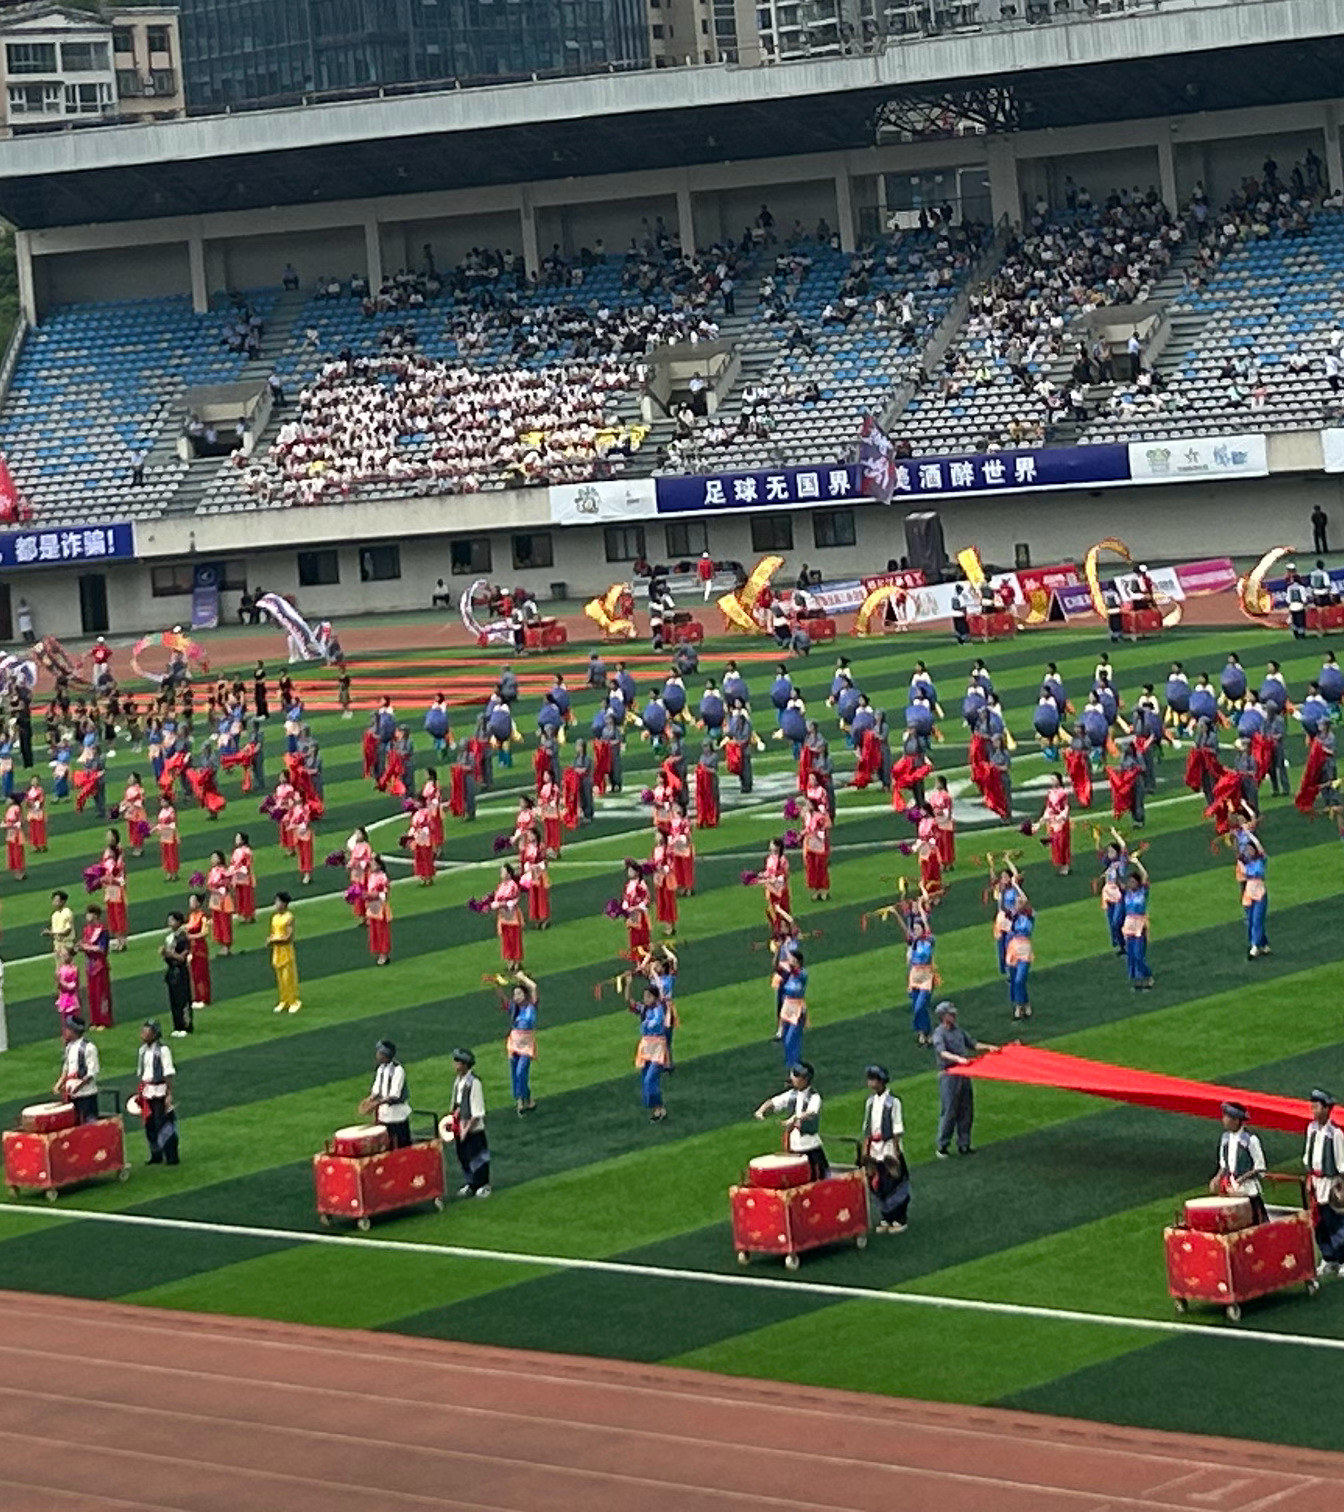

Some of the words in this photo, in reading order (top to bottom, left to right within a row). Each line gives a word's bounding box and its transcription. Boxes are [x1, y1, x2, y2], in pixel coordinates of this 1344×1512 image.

[704, 469, 851, 505] 足球无国界
